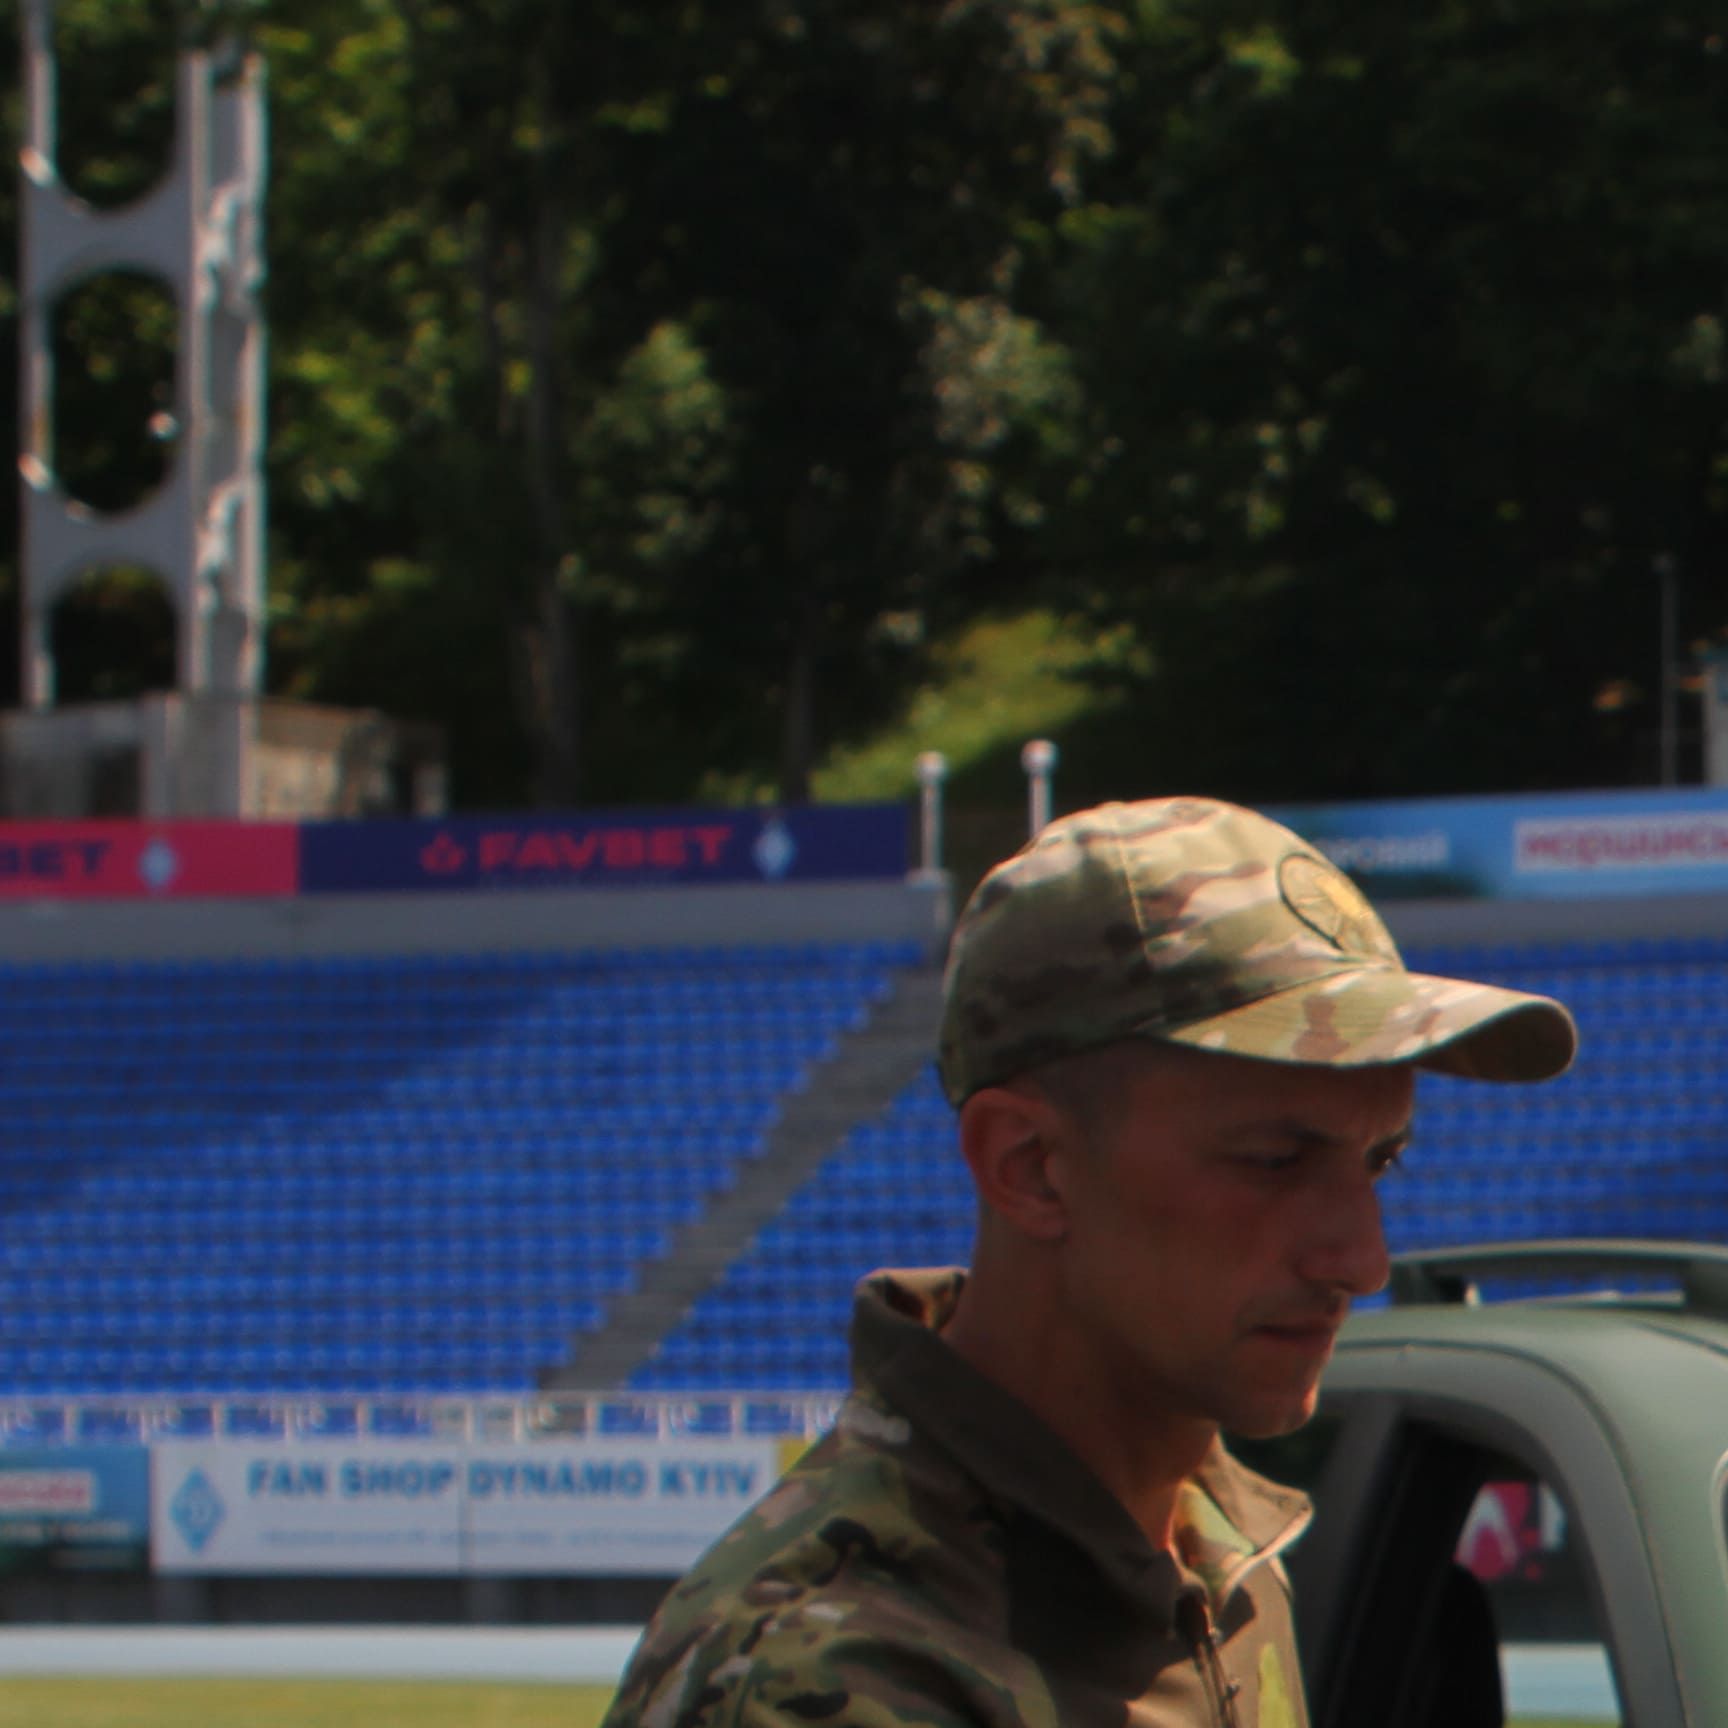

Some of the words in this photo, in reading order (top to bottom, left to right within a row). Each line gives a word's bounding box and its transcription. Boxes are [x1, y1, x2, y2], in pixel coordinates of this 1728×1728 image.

[480, 828, 731, 871] FAVBET
[247, 1460, 328, 1498] FAN
[339, 1460, 455, 1498] SHOP
[468, 1459, 646, 1498] DYNAMO
[659, 1460, 757, 1498] KYIV
